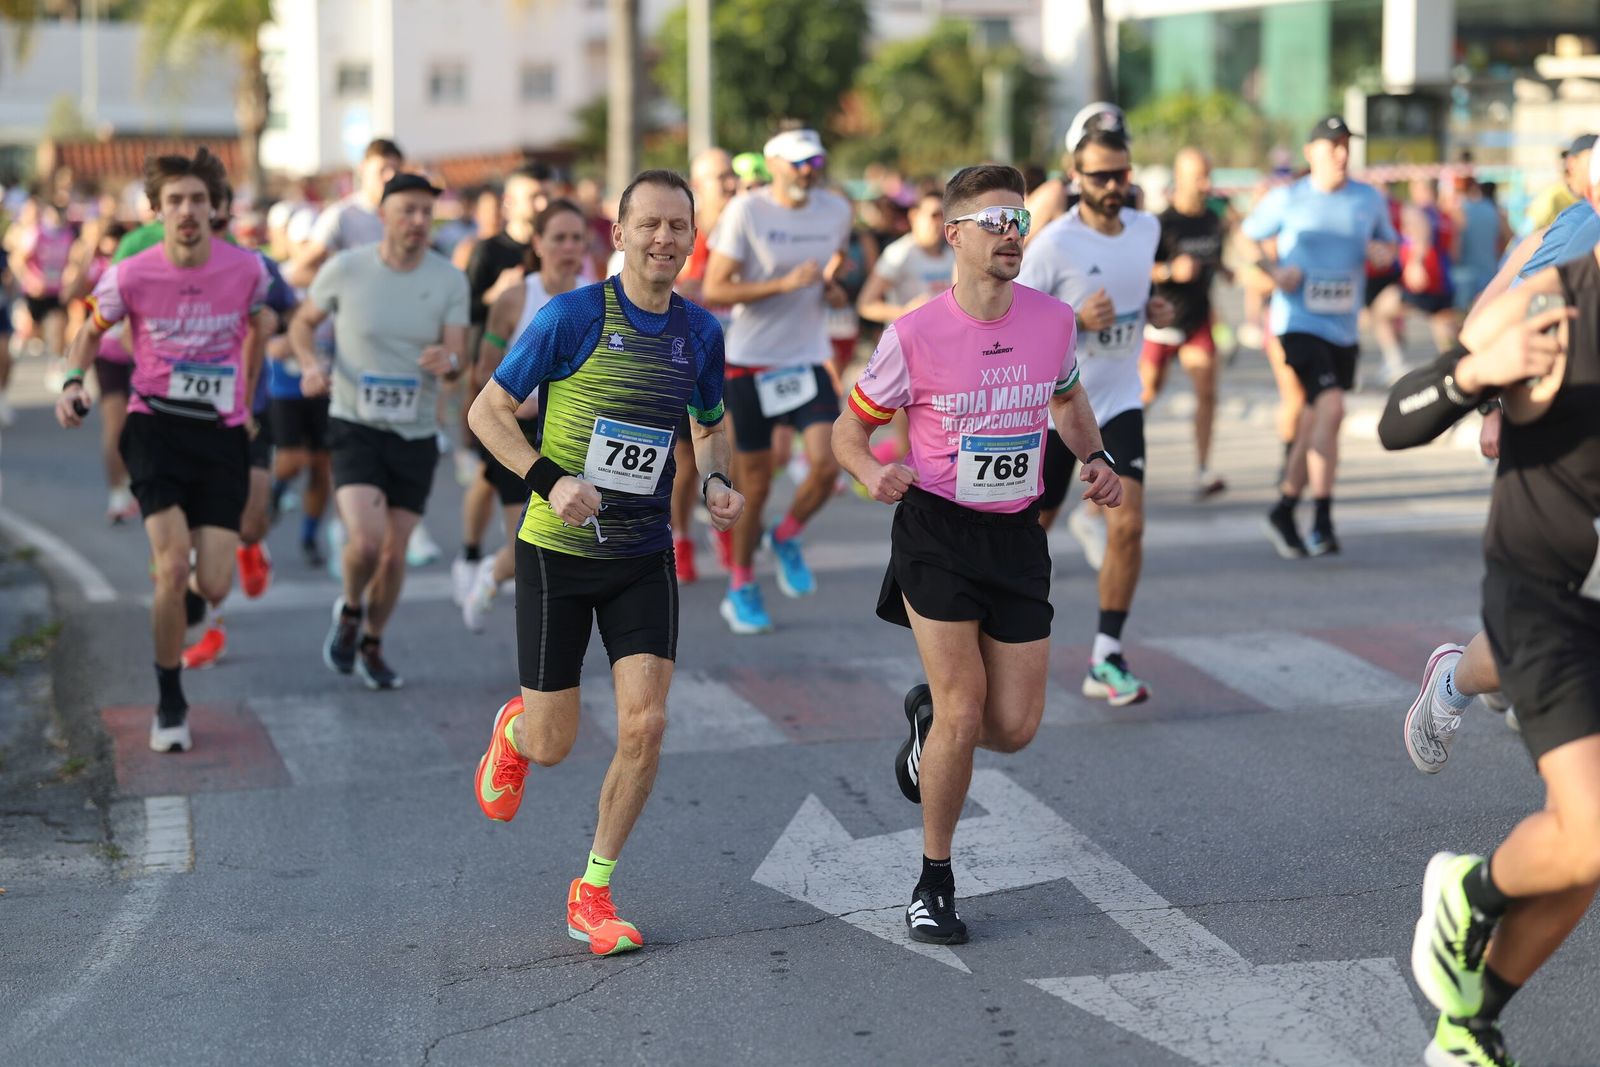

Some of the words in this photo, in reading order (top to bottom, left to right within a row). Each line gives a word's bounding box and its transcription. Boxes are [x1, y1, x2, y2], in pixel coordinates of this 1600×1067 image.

[182, 376, 221, 395] 701
[980, 364, 1027, 386] XXXVI
[931, 390, 987, 416] MEDIA
[942, 410, 1034, 433] INTERNACIONAL
[605, 440, 657, 473] 782
[974, 453, 1029, 480] 768
